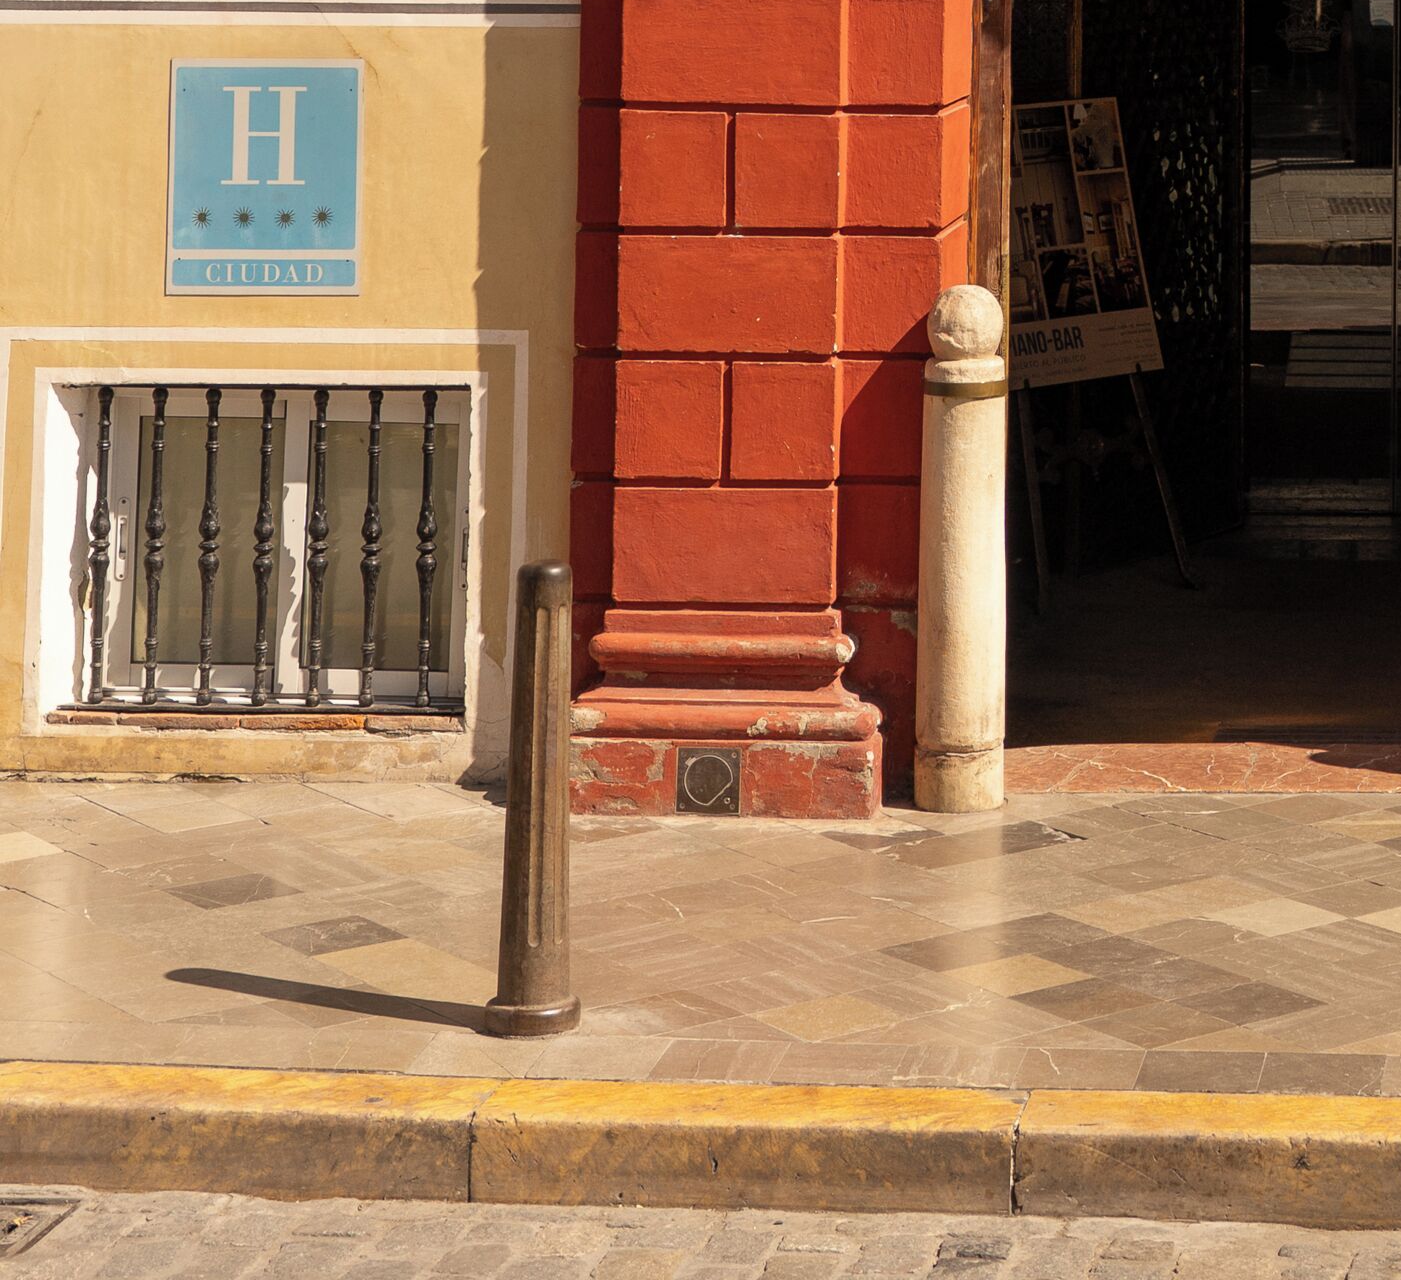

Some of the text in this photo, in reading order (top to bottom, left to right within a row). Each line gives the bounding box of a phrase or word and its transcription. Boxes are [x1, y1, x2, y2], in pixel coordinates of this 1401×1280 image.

[220, 86, 308, 185] H
[205, 263, 324, 283] CIUDAD
[1010, 326, 1085, 357] IANO-BAR
